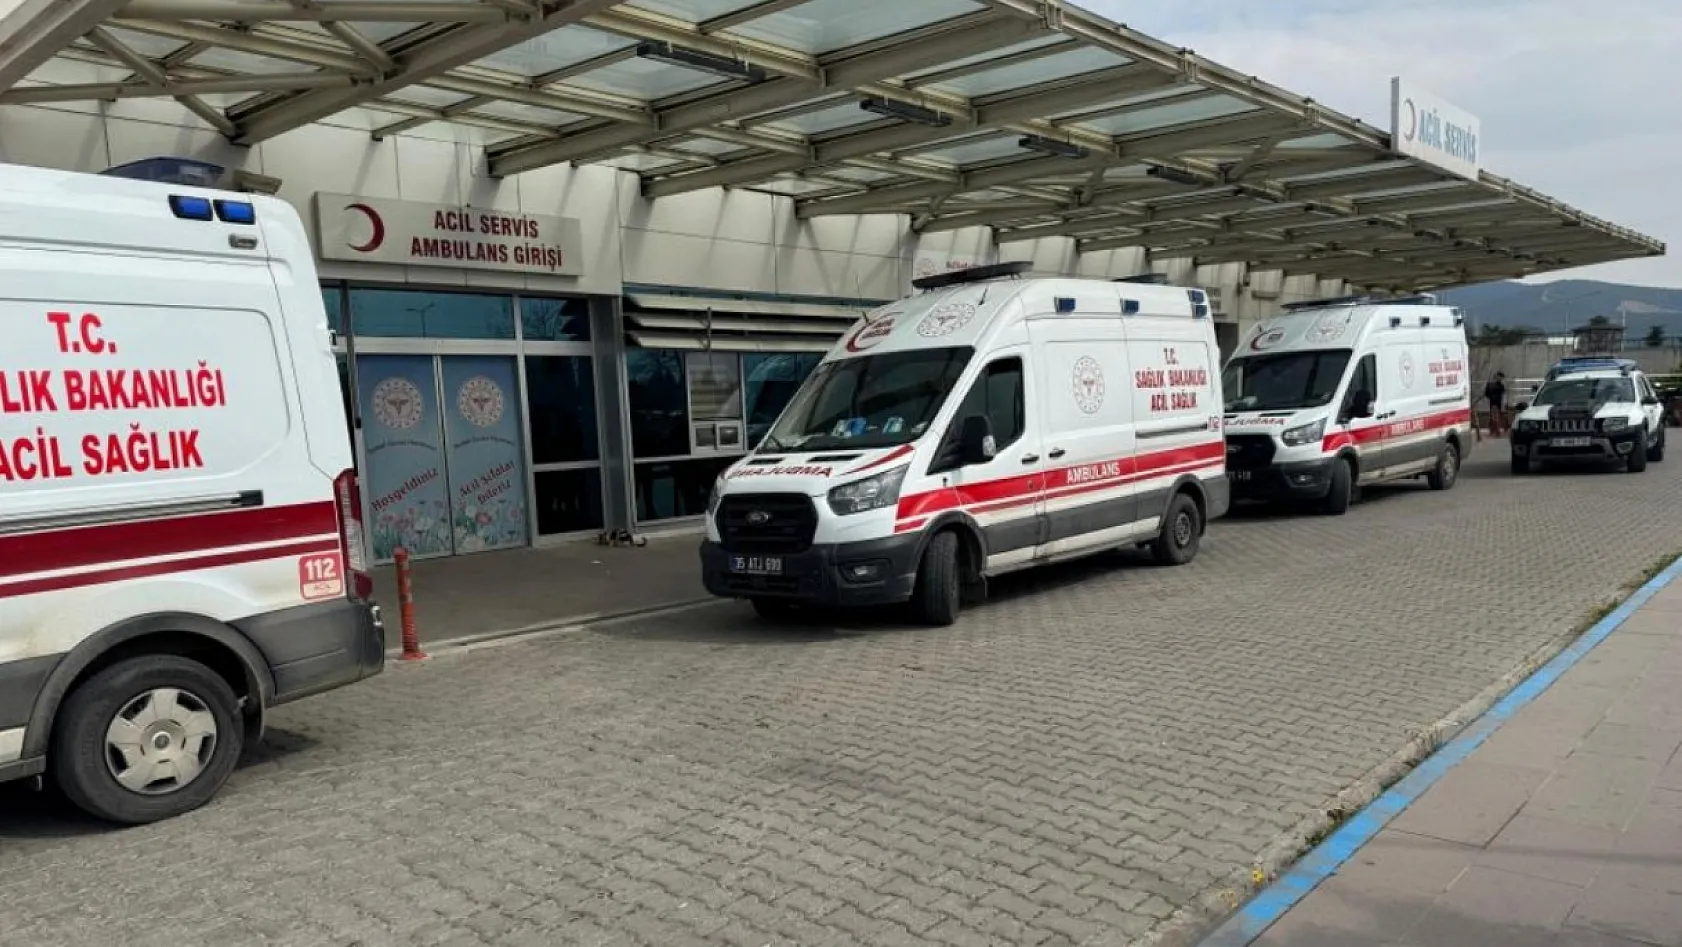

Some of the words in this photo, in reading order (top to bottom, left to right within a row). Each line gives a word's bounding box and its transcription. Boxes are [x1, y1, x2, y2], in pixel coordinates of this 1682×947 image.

[1419, 107, 1442, 152] ACİL
[434, 209, 475, 233] ACİL
[480, 214, 539, 239] SERVİS
[411, 236, 508, 263] AMBULANS
[513, 242, 562, 271] GİRİŞİ
[47, 312, 118, 353] T.C.
[63, 359, 226, 410] BAKANLIĞI
[1135, 366, 1166, 388] SAĞLIK
[0, 427, 73, 480] ACİL
[81, 421, 204, 475] SAĞLIK
[1067, 462, 1120, 484] AMBULANS
[304, 558, 337, 580] 112
